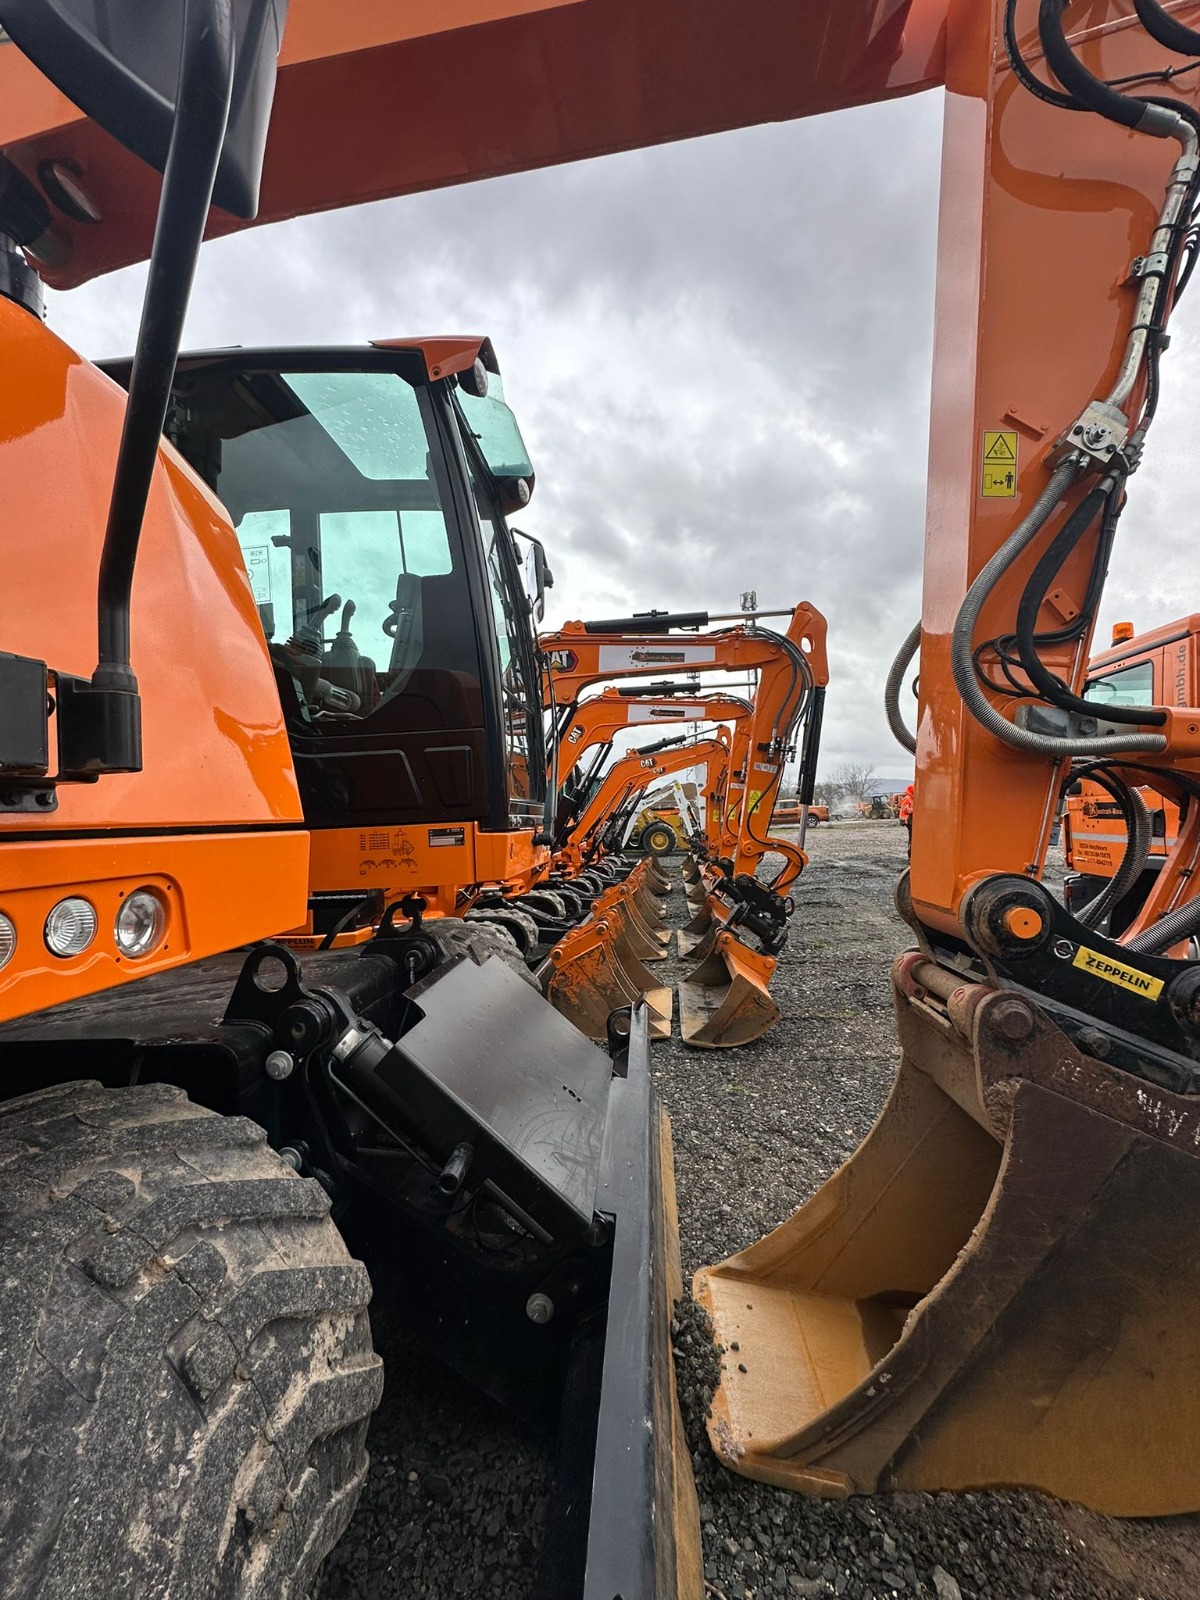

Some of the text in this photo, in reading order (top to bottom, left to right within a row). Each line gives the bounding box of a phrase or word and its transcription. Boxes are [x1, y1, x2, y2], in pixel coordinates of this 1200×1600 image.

[568, 726, 582, 744] CAT
[640, 757, 654, 768] CAT
[1085, 957, 1150, 991] ZEPPELIN
